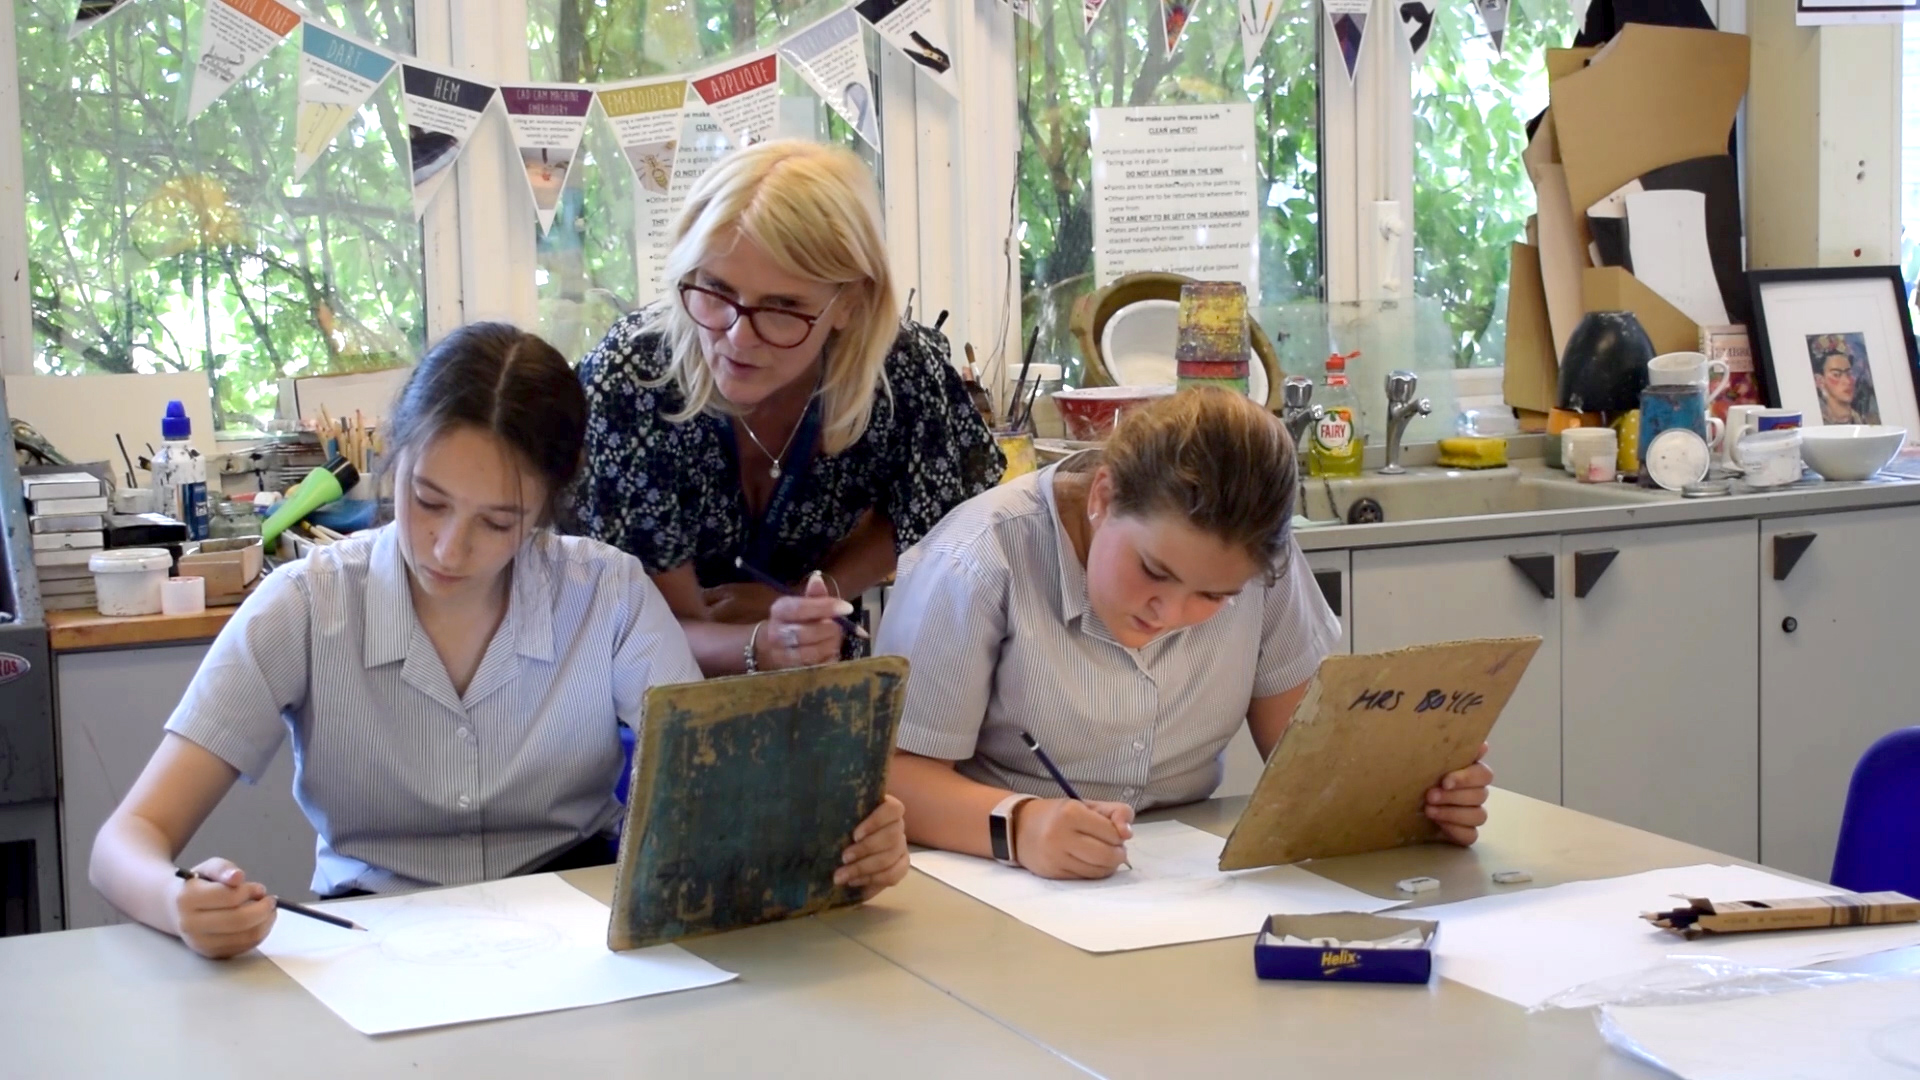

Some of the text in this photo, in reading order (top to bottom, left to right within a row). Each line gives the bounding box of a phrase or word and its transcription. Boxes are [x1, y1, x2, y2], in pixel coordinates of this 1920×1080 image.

[260, 1, 291, 34] LINE
[326, 39, 362, 69] DART
[433, 76, 461, 104] HEM
[710, 62, 770, 99] APPLIQUE
[607, 85, 680, 115] EMBROIDERY
[695, 124, 718, 132] CLEAN
[1148, 127, 1168, 135] CLEAN
[1136, 170, 1149, 178] NOT
[1151, 169, 1169, 177] LEAVE
[1171, 168, 1188, 176] THEM
[1197, 167, 1208, 175] THE
[1209, 167, 1223, 175] SINK
[1109, 216, 1125, 224] THEY
[1126, 215, 1138, 223] ARE
[1139, 214, 1152, 222] NOT
[1153, 214, 1162, 222] TO
[1163, 213, 1171, 221] BE
[1172, 212, 1185, 221] LEFT
[1186, 212, 1196, 220] ON
[1197, 211, 1208, 219] THE
[1320, 424, 1346, 438] FAIRY
[1348, 689, 1405, 711] MRS
[1321, 948, 1357, 967] Helix
